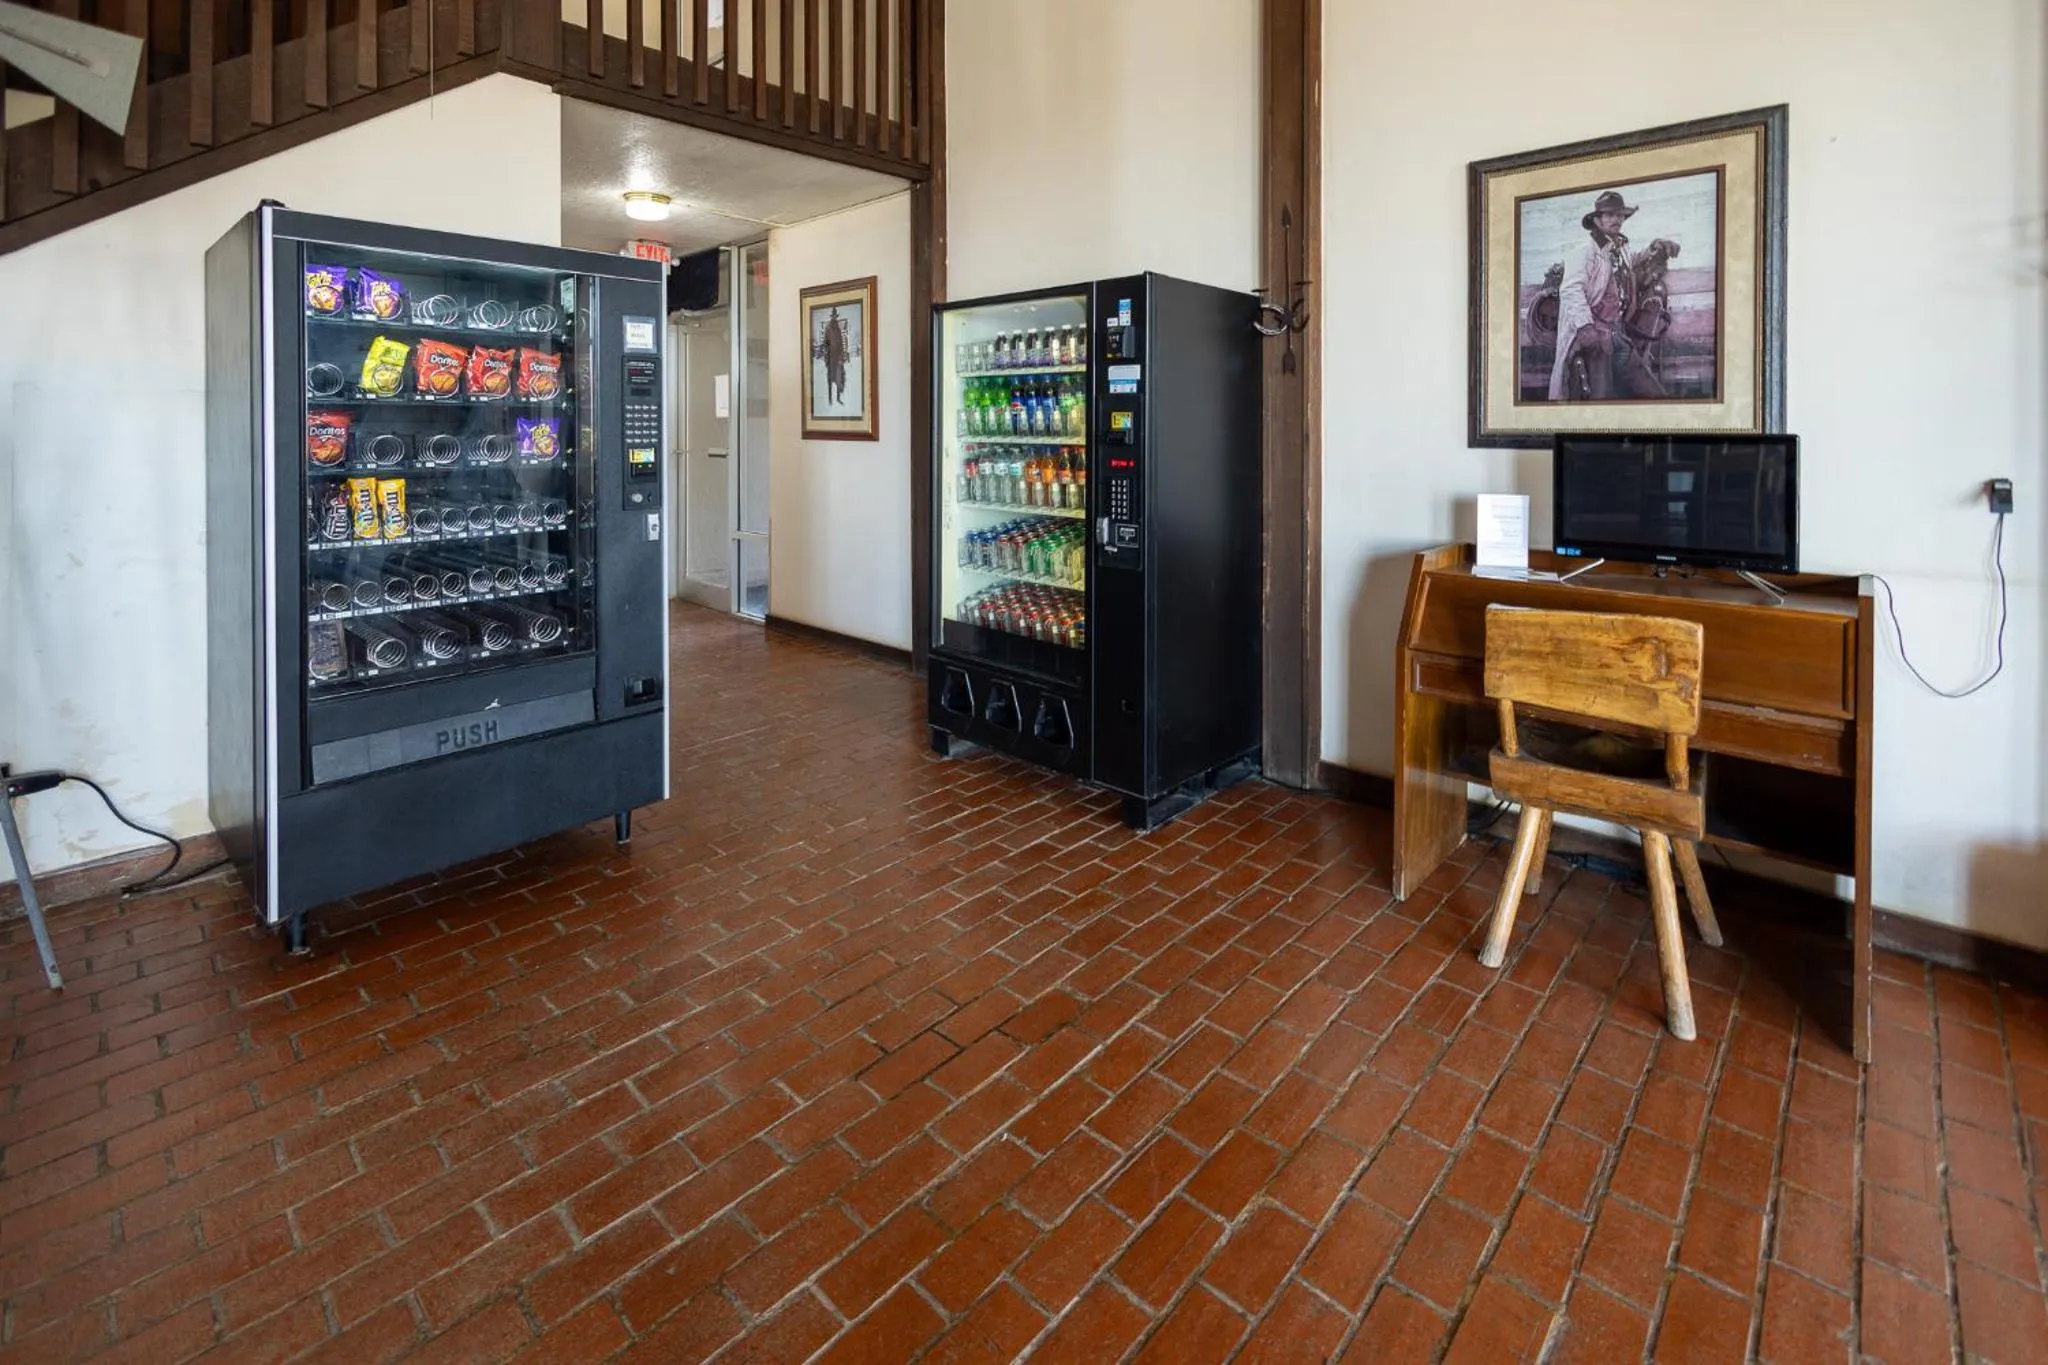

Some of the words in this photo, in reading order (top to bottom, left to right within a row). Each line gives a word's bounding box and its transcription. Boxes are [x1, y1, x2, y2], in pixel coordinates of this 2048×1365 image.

[635, 243, 665, 259] EXIT
[309, 427, 345, 436] Doritos
[436, 720, 499, 752] PUSH
